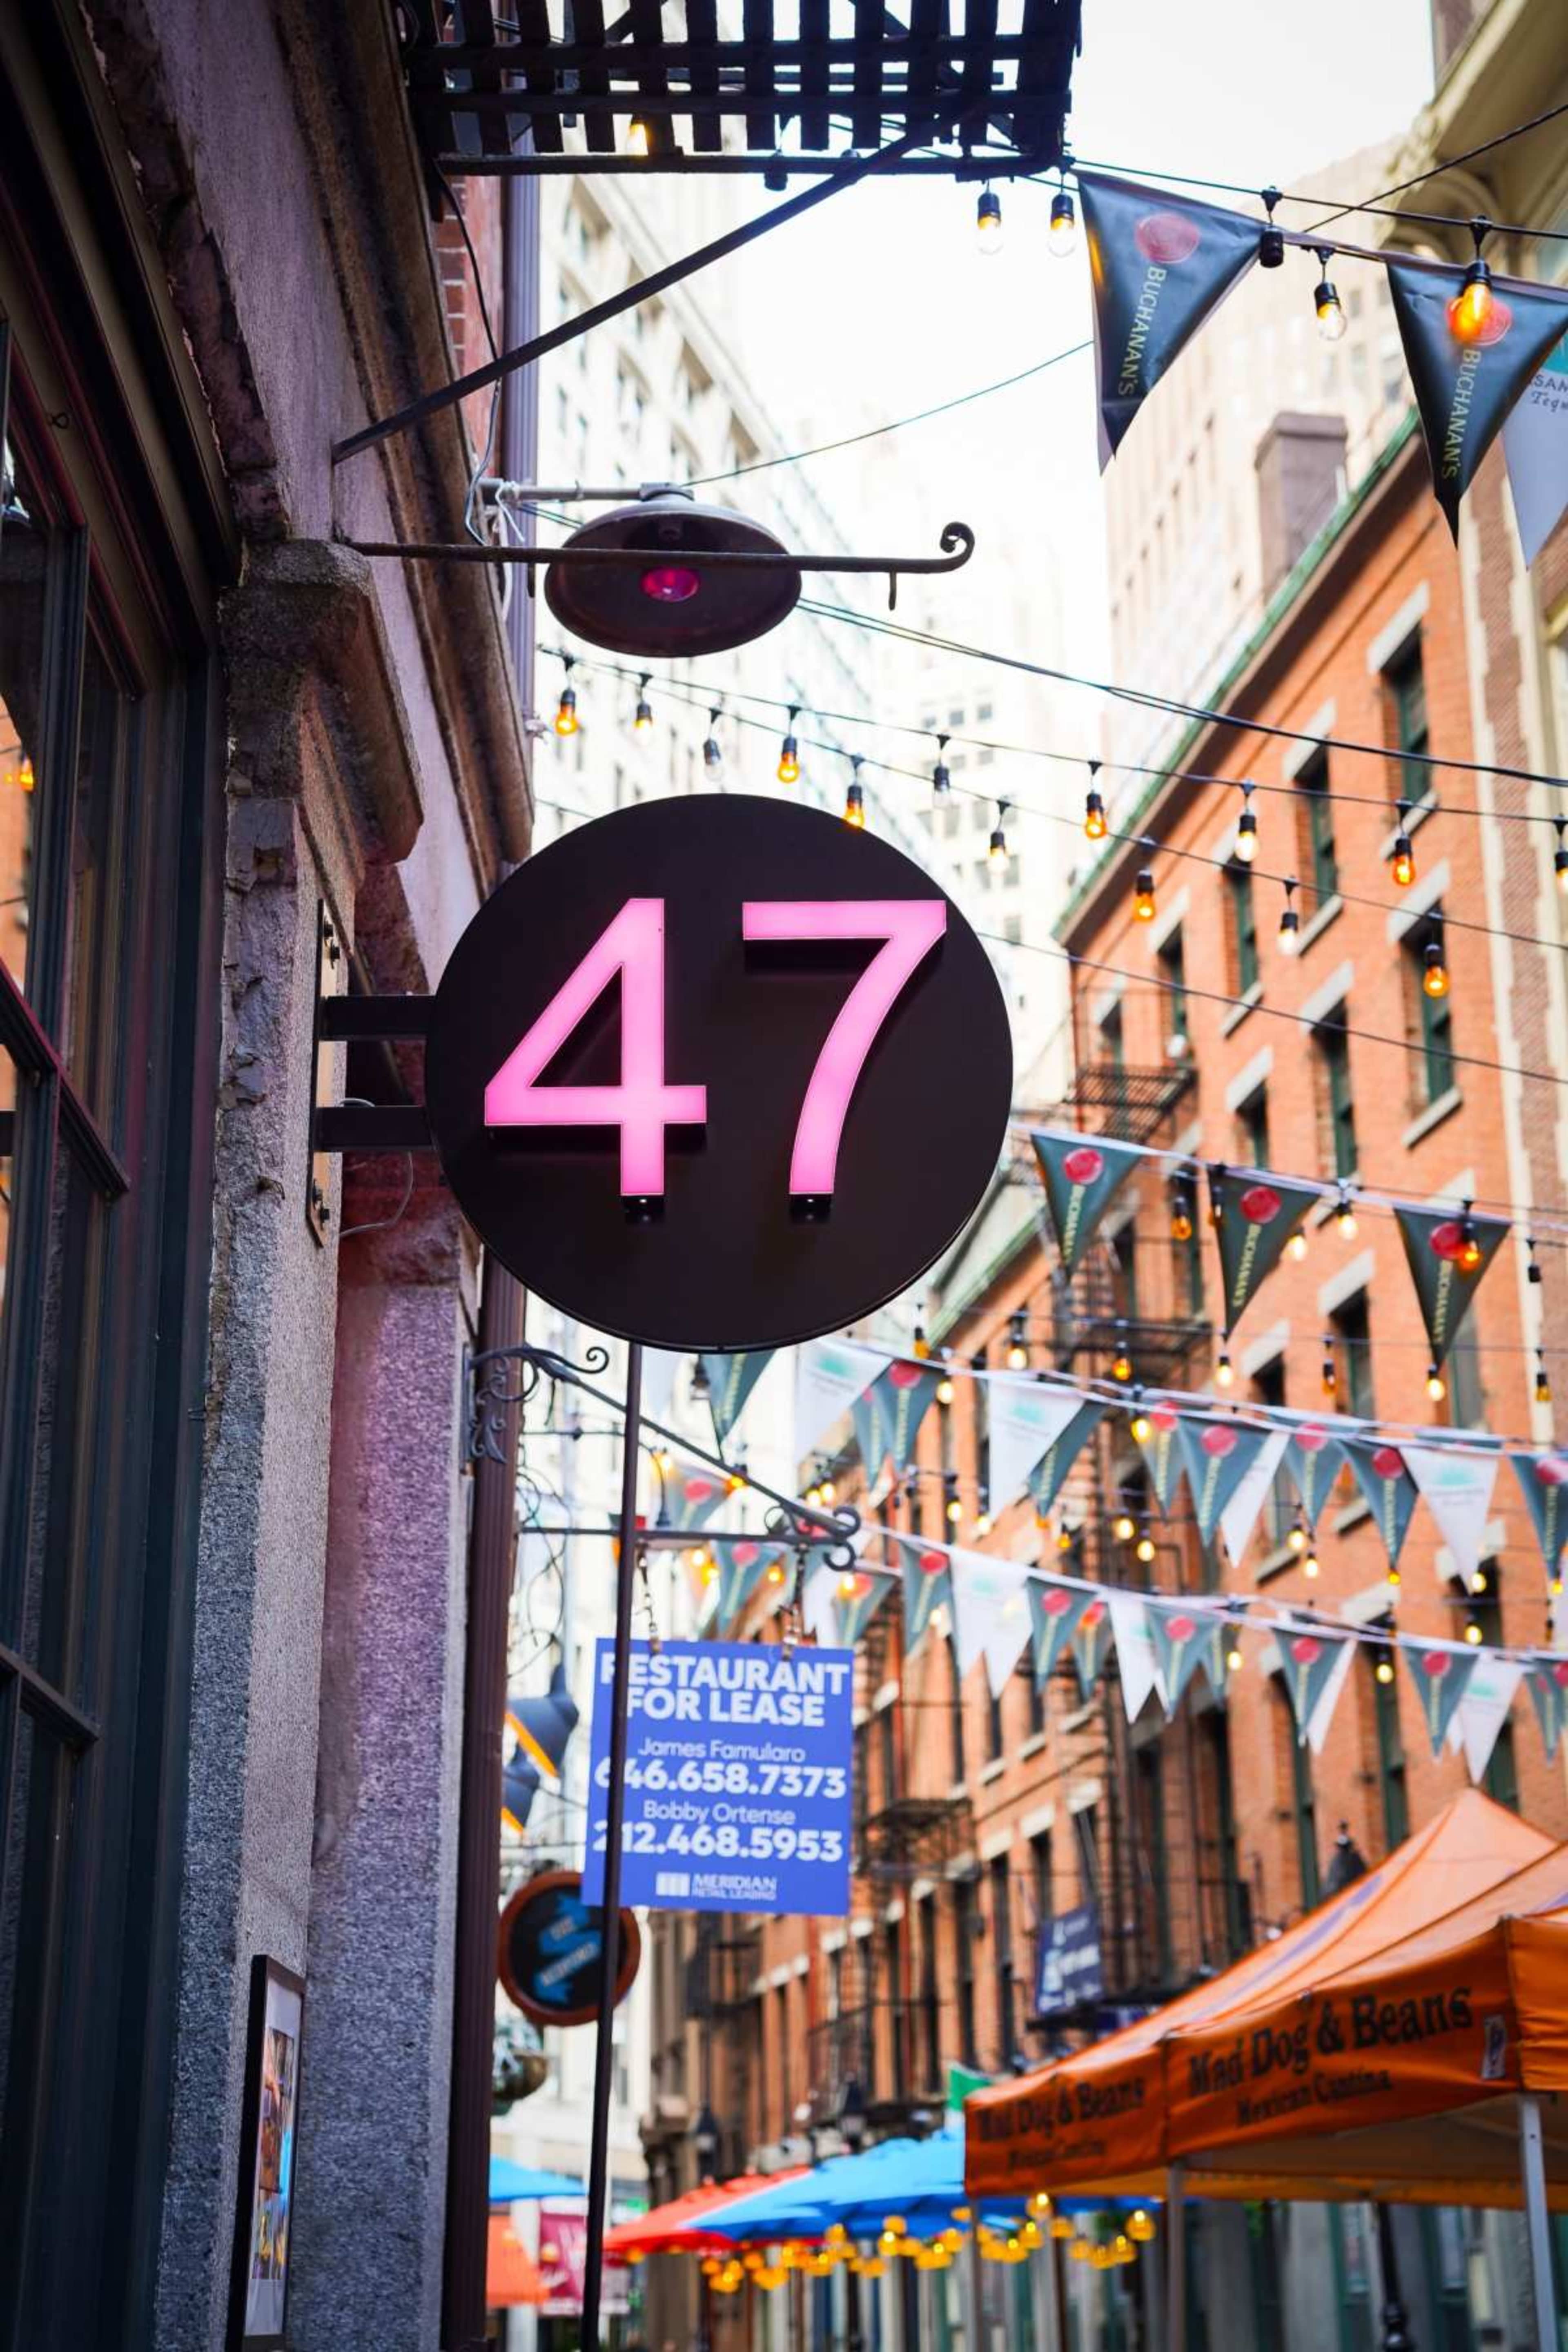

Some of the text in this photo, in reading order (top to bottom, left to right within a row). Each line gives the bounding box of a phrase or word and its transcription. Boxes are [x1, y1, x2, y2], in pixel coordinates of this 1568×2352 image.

[1118, 265, 1167, 396] BUCHANAN'S
[1441, 349, 1482, 479] BUCHANAN'S
[484, 898, 947, 1196] 47
[627, 1686, 825, 1727] FOR LEASE
[638, 1737, 806, 1763] James Famularo
[643, 1799, 796, 1826] Bobby Ortense
[1188, 2039, 1244, 2098] Mad
[1252, 2021, 1310, 2075] Dog
[1316, 1998, 1344, 2056] &
[1351, 1987, 1473, 2050] Beans
